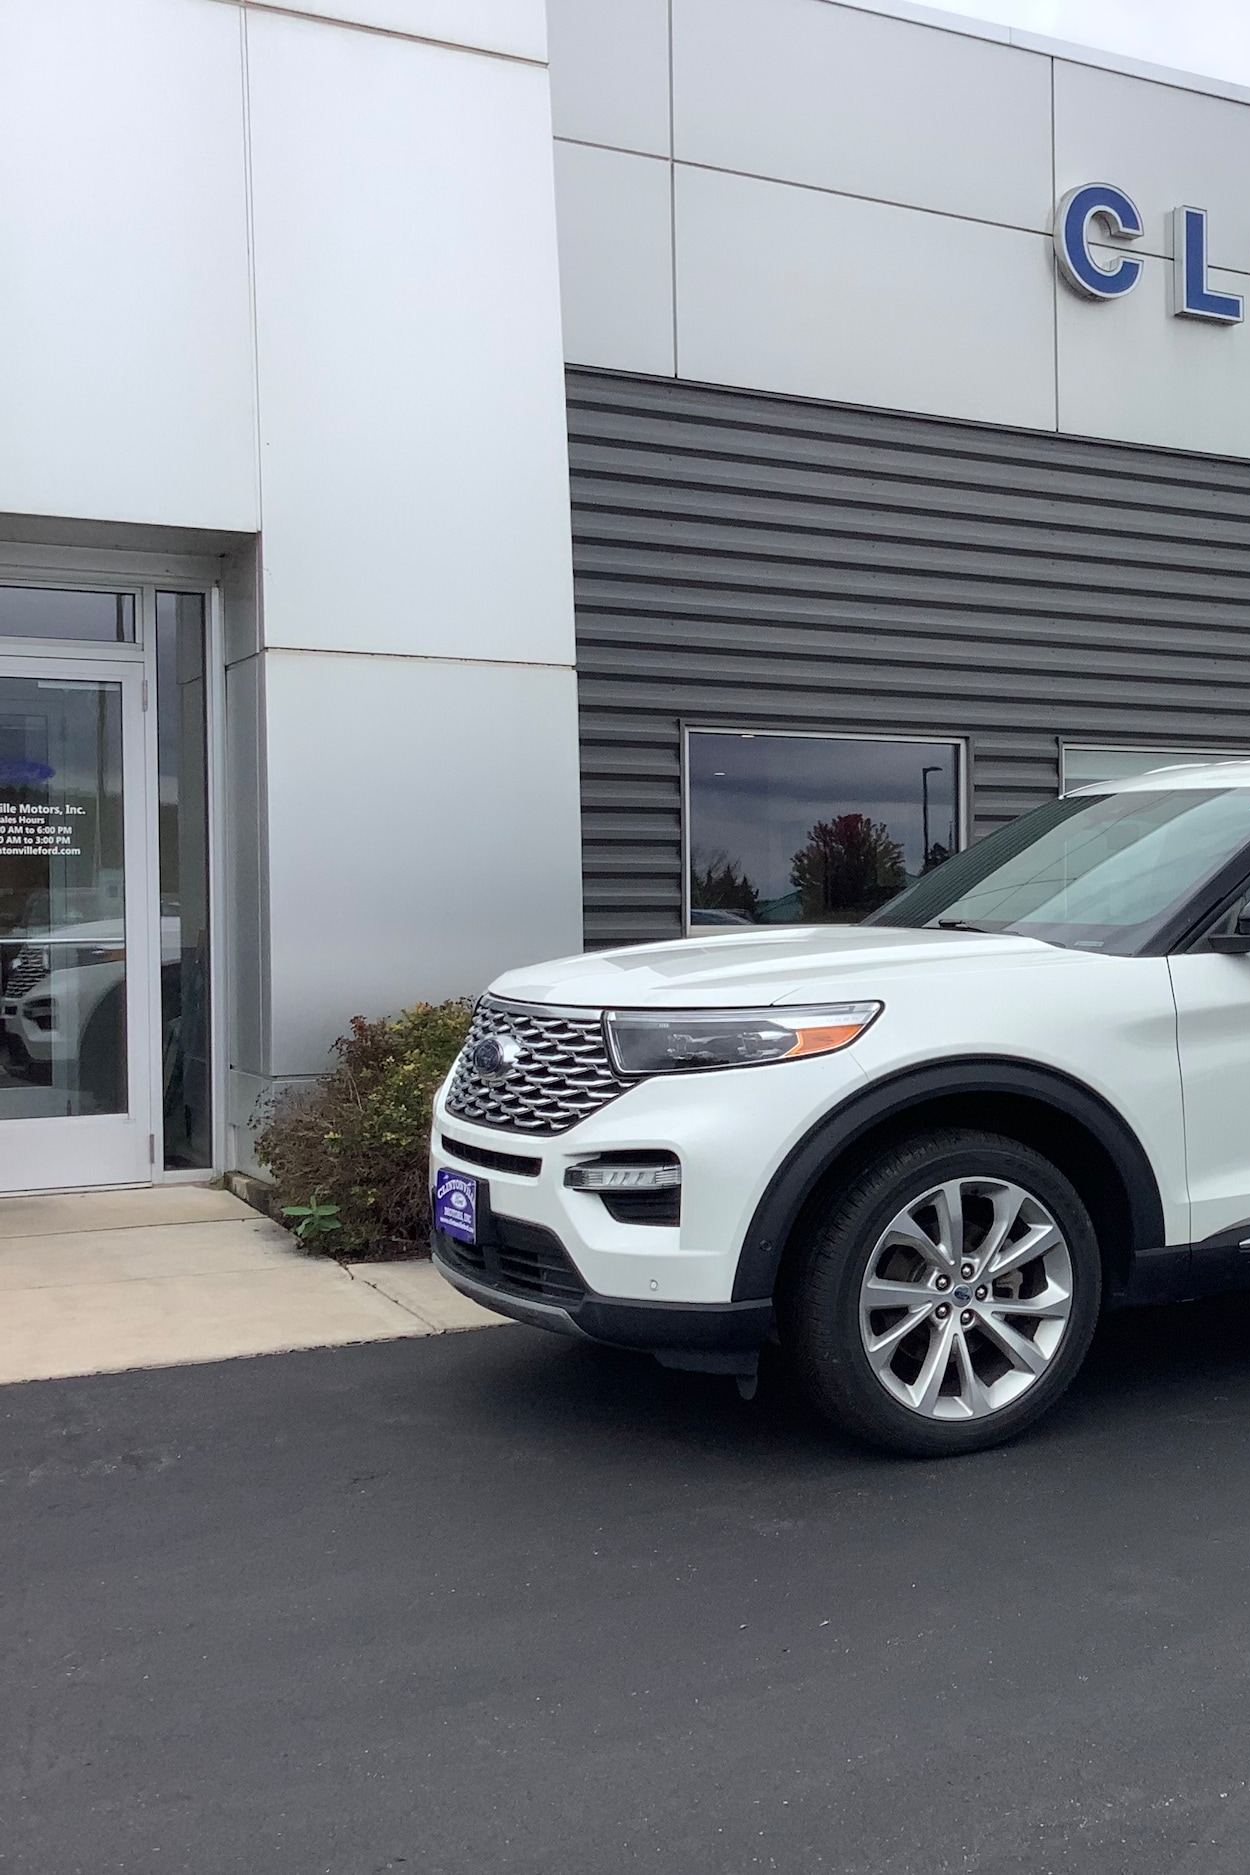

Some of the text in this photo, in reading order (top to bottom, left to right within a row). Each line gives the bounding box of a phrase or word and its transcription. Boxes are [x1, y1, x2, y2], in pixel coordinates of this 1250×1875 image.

[19, 803, 63, 815] Motors,
[65, 804, 86, 815] Inc.
[18, 815, 45, 824] Hours
[7, 826, 23, 834] AM
[25, 826, 35, 834] to
[37, 826, 56, 834] 6:00
[57, 826, 73, 834] PM
[6, 836, 21, 844] AM
[24, 836, 34, 844] to
[35, 836, 54, 844] 3:00
[56, 836, 71, 844] PM
